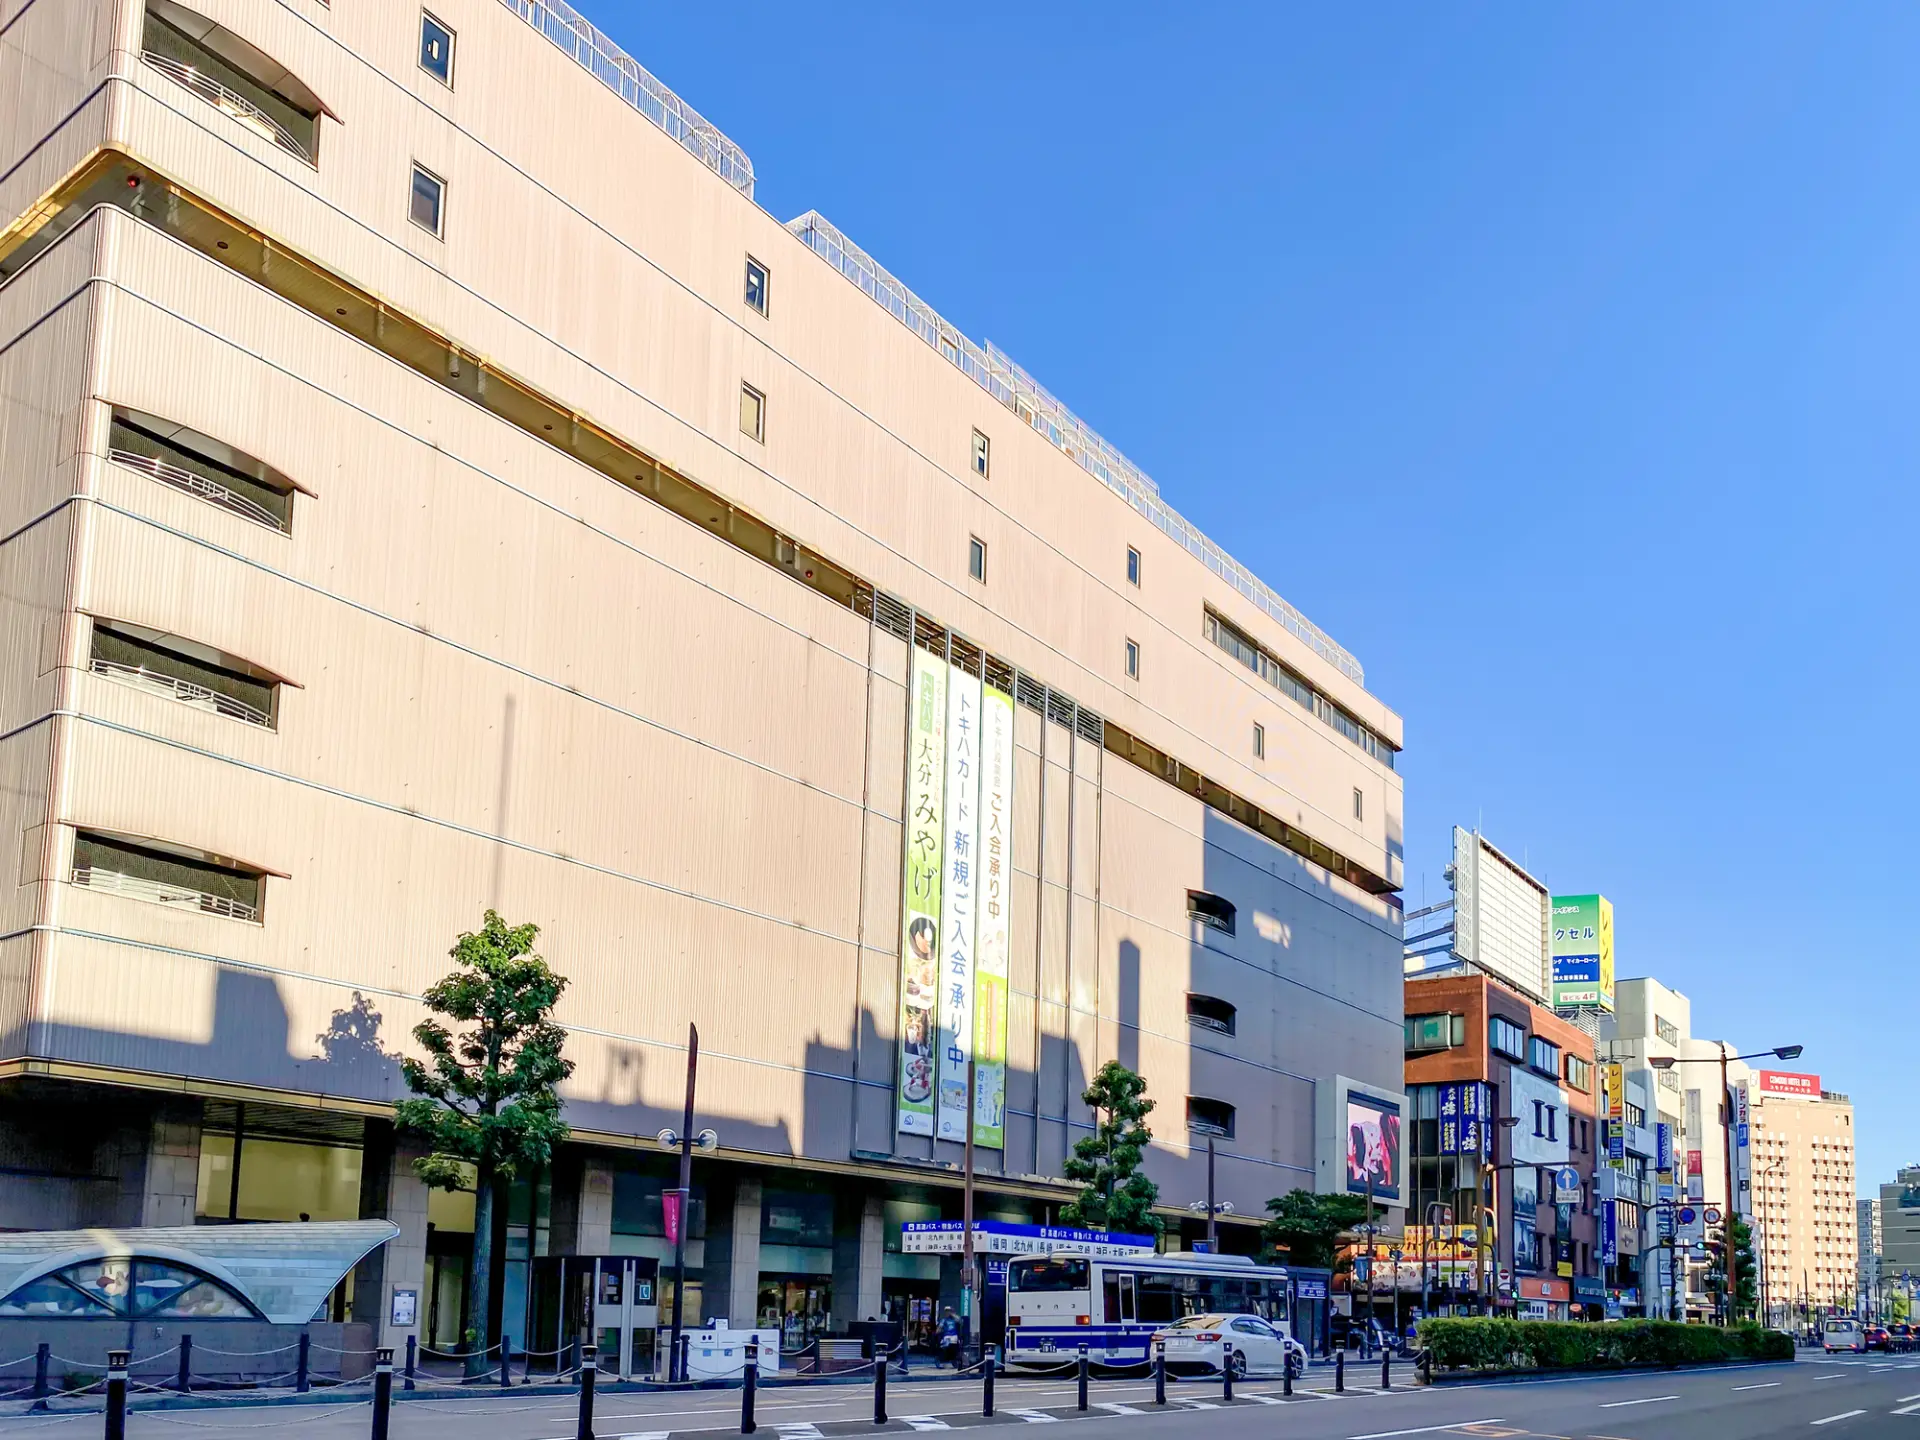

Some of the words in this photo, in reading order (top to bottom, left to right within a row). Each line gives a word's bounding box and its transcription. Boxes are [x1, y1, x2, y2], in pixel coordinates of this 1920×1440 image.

[913, 738, 938, 900] 大分みやげ
[1555, 927, 1594, 941] クセル
[992, 1237, 1008, 1251] 福岡
[1014, 1239, 1034, 1252] 北九州
